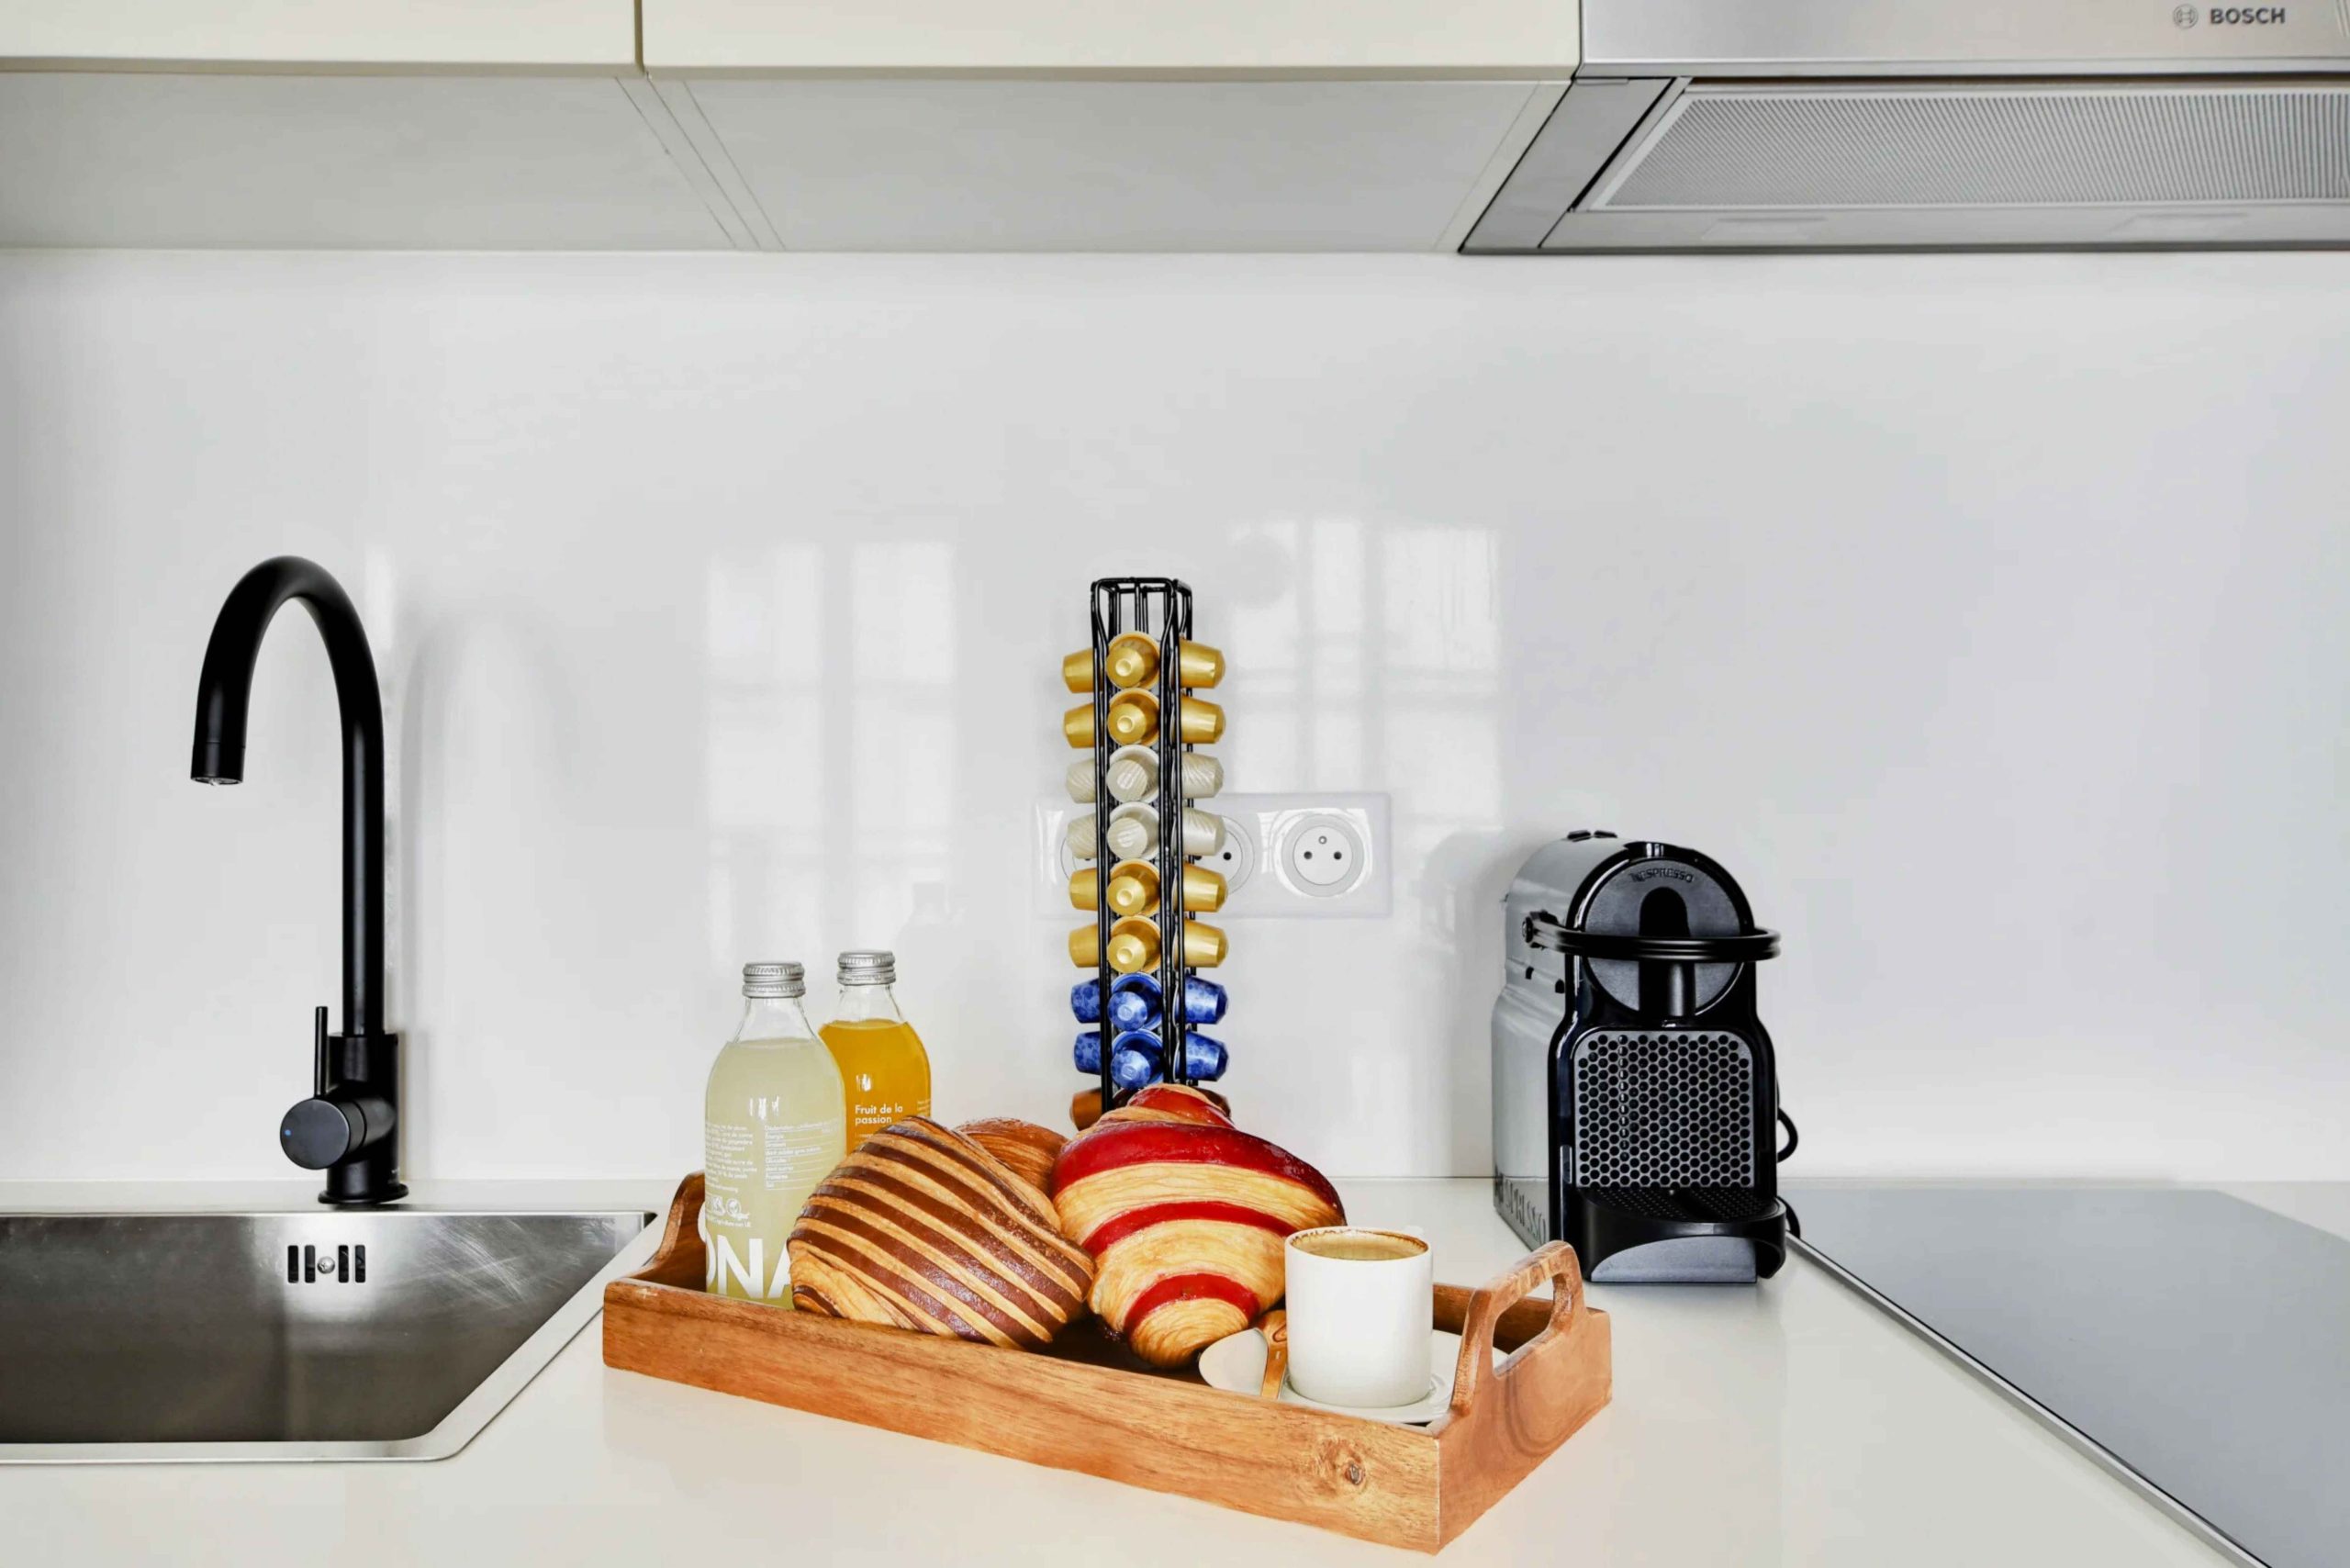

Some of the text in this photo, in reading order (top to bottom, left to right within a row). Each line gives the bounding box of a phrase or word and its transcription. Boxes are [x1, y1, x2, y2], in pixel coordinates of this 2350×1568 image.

[2210, 7, 2286, 25] BOSCH
[1628, 868, 1694, 883] NESPRESSO
[855, 1103, 903, 1114] Fruit de la
[855, 1114, 892, 1127] passion
